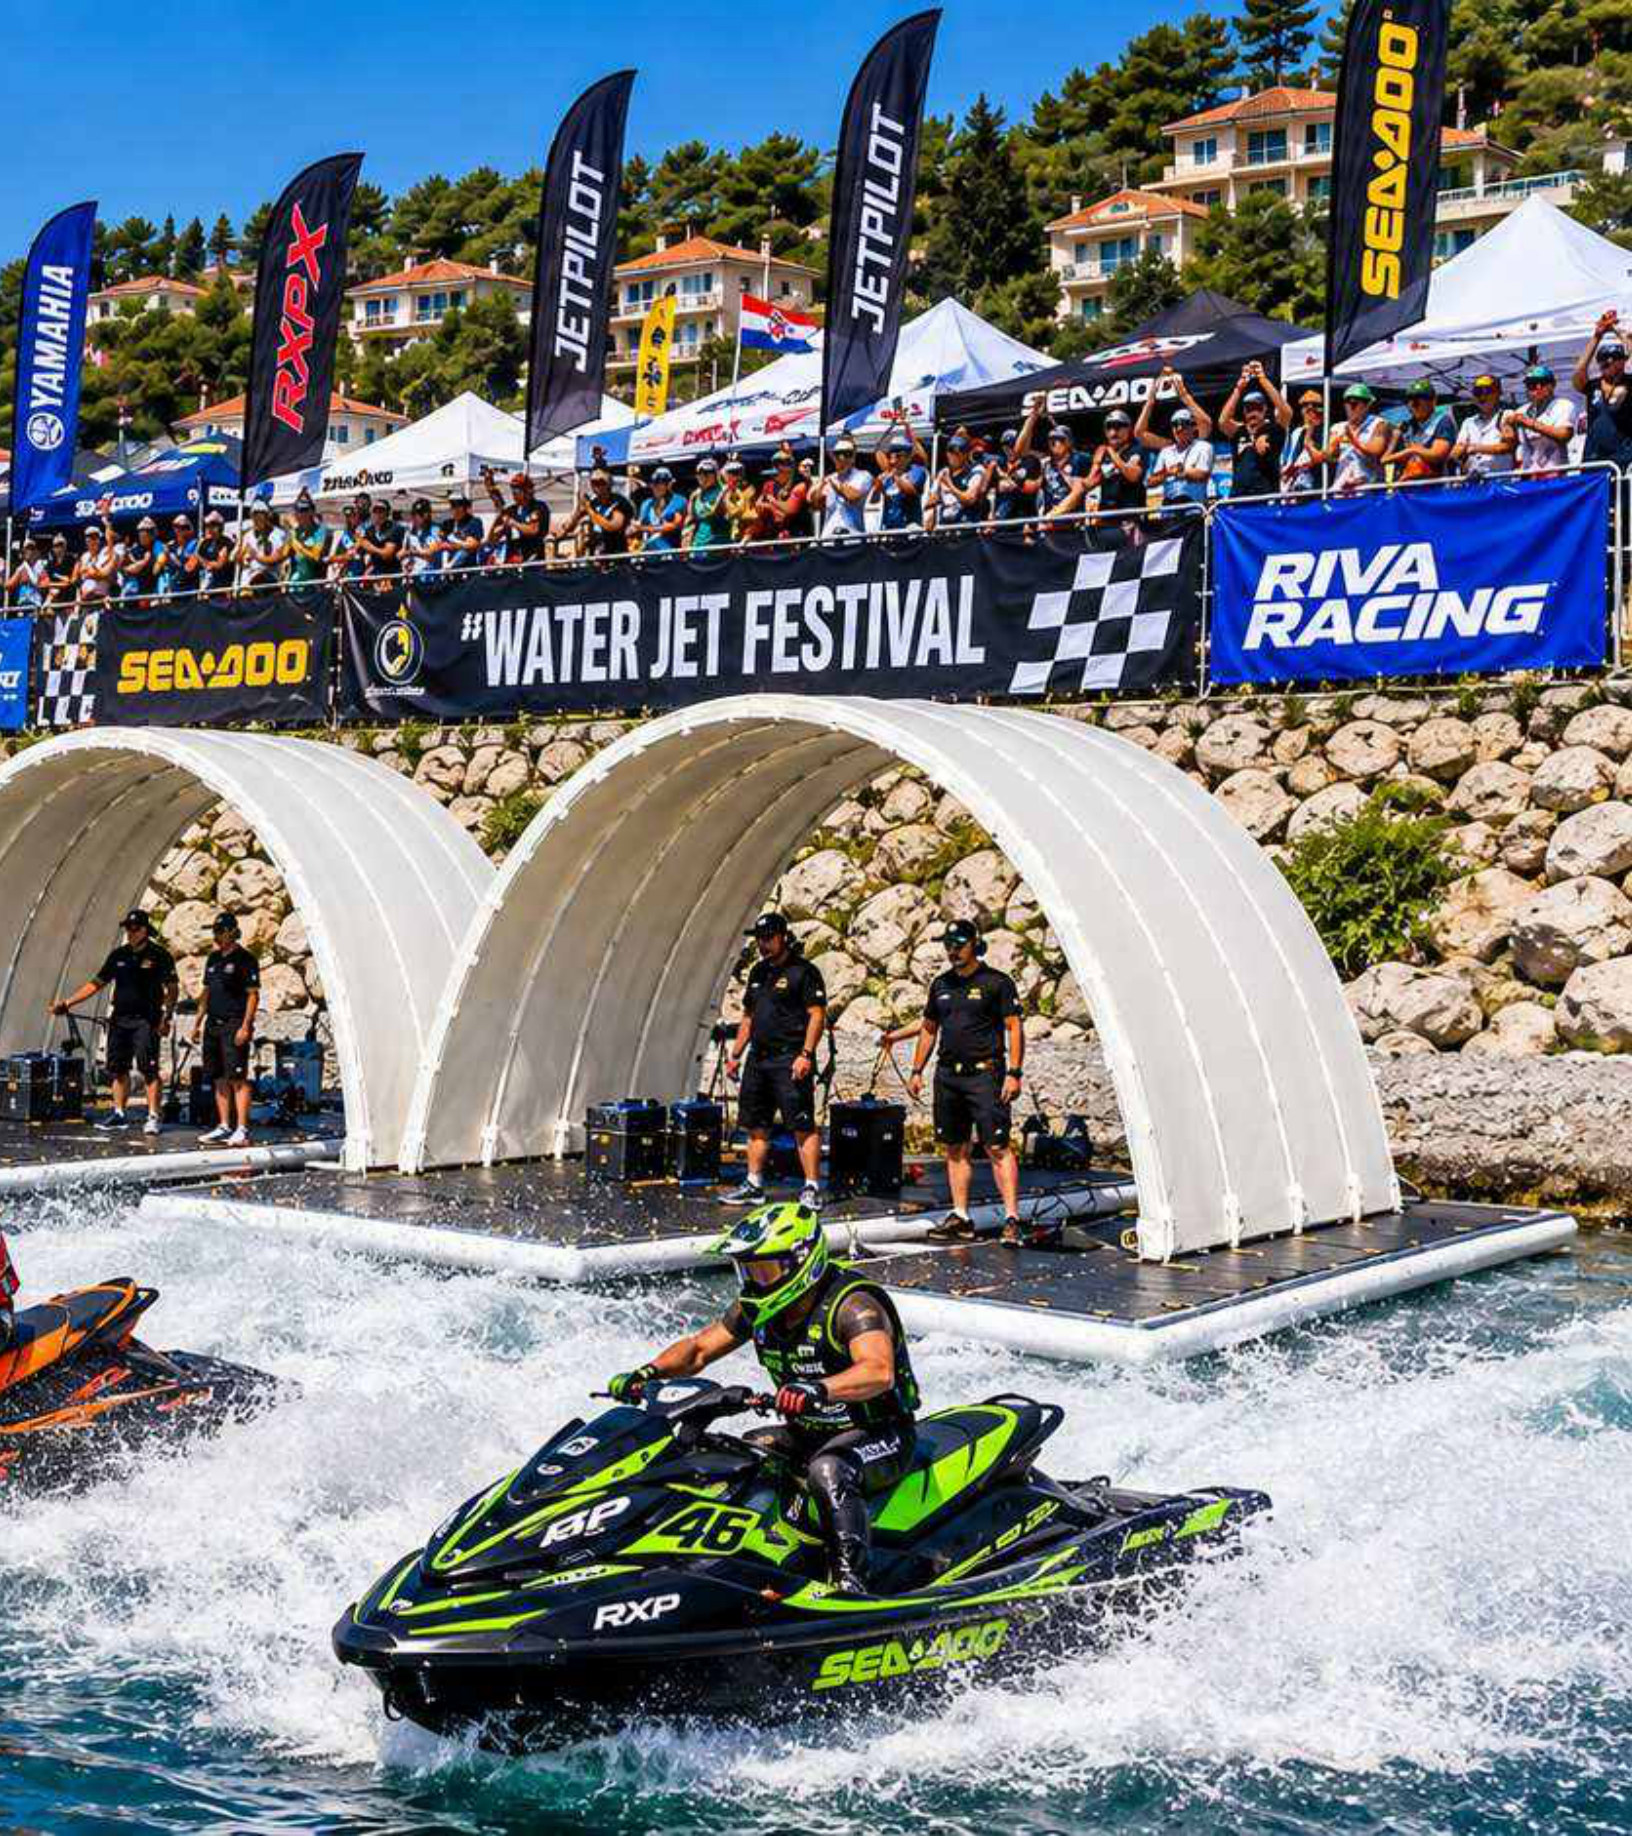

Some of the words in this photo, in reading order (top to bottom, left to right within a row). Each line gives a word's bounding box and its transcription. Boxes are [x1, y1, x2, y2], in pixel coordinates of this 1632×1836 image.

[851, 102, 905, 334] JETPILOT
[554, 150, 605, 372] JETPILOT
[1254, 543, 1439, 601] RIVA
[461, 600, 640, 687] #WATER
[650, 592, 729, 680] JET
[742, 574, 985, 676] FESTIVAL
[1242, 583, 1549, 650] RACING
[656, 1503, 755, 1551] 46
[593, 1593, 681, 1631] RXP
